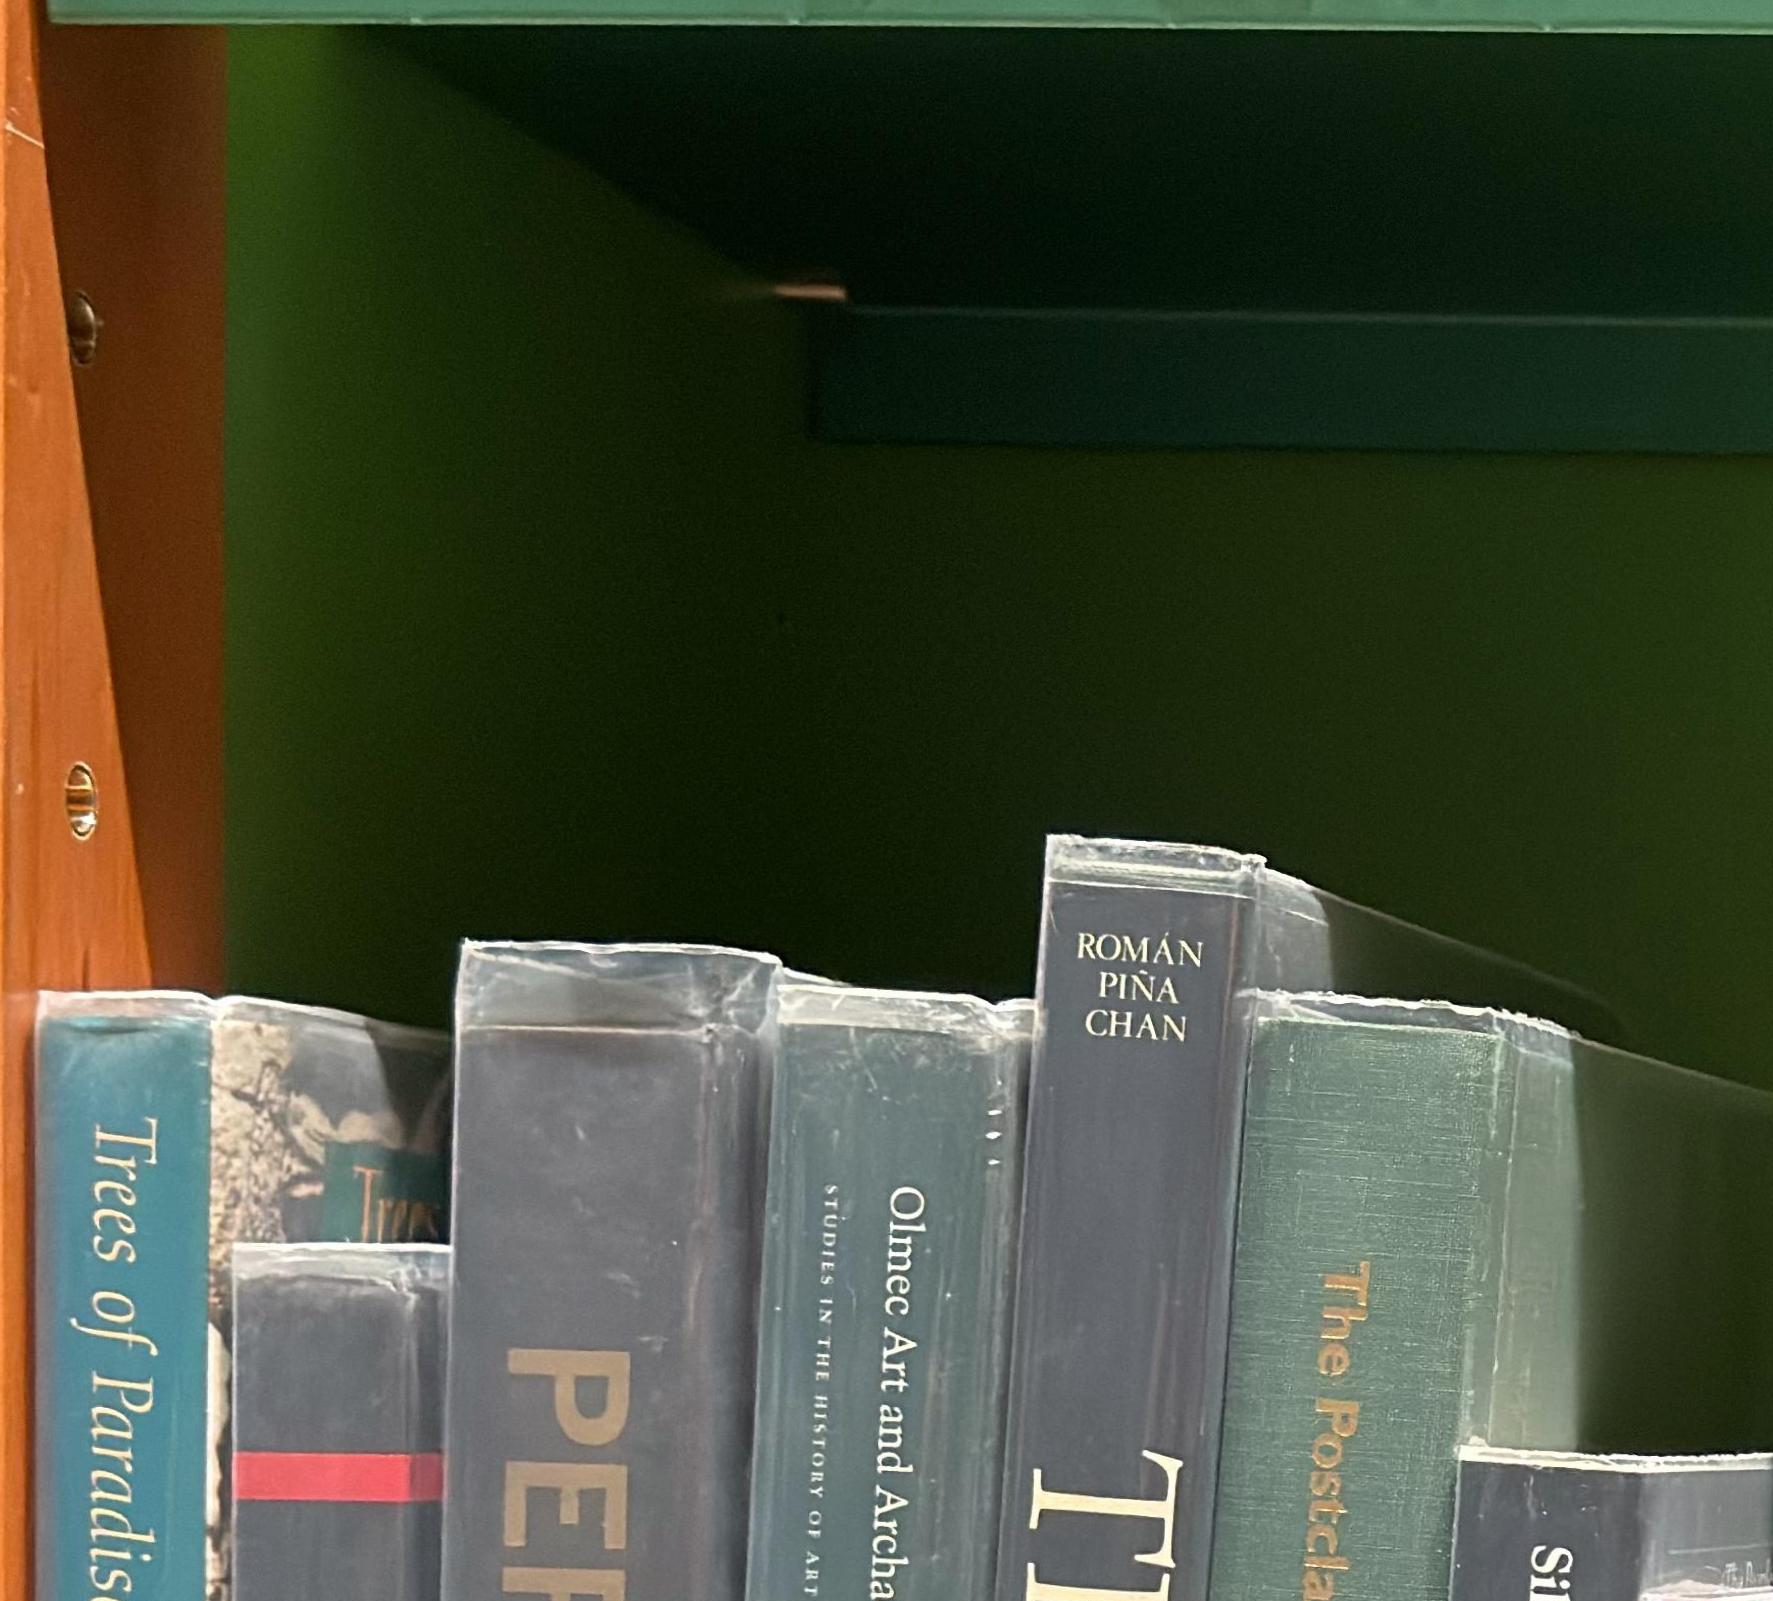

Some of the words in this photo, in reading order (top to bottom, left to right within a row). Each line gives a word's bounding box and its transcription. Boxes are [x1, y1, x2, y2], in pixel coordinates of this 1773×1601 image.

[1077, 932, 1203, 968] ROMÁN
[1099, 969, 1179, 1004] PIÑA
[1085, 1009, 1187, 1042] CHAN
[92, 1117, 158, 1263] Trees
[820, 1185, 838, 1285] STUDIES
[885, 1186, 926, 1317] Olmec
[70, 1291, 159, 1357] of
[819, 1299, 833, 1322] IN
[1318, 1260, 1370, 1377] The
[815, 1339, 831, 1381] THE
[880, 1326, 918, 1393] Art
[809, 1395, 828, 1498] HISTORY
[876, 1404, 914, 1474] and
[807, 1510, 822, 1537] OF
[804, 1551, 820, 1595] ART
